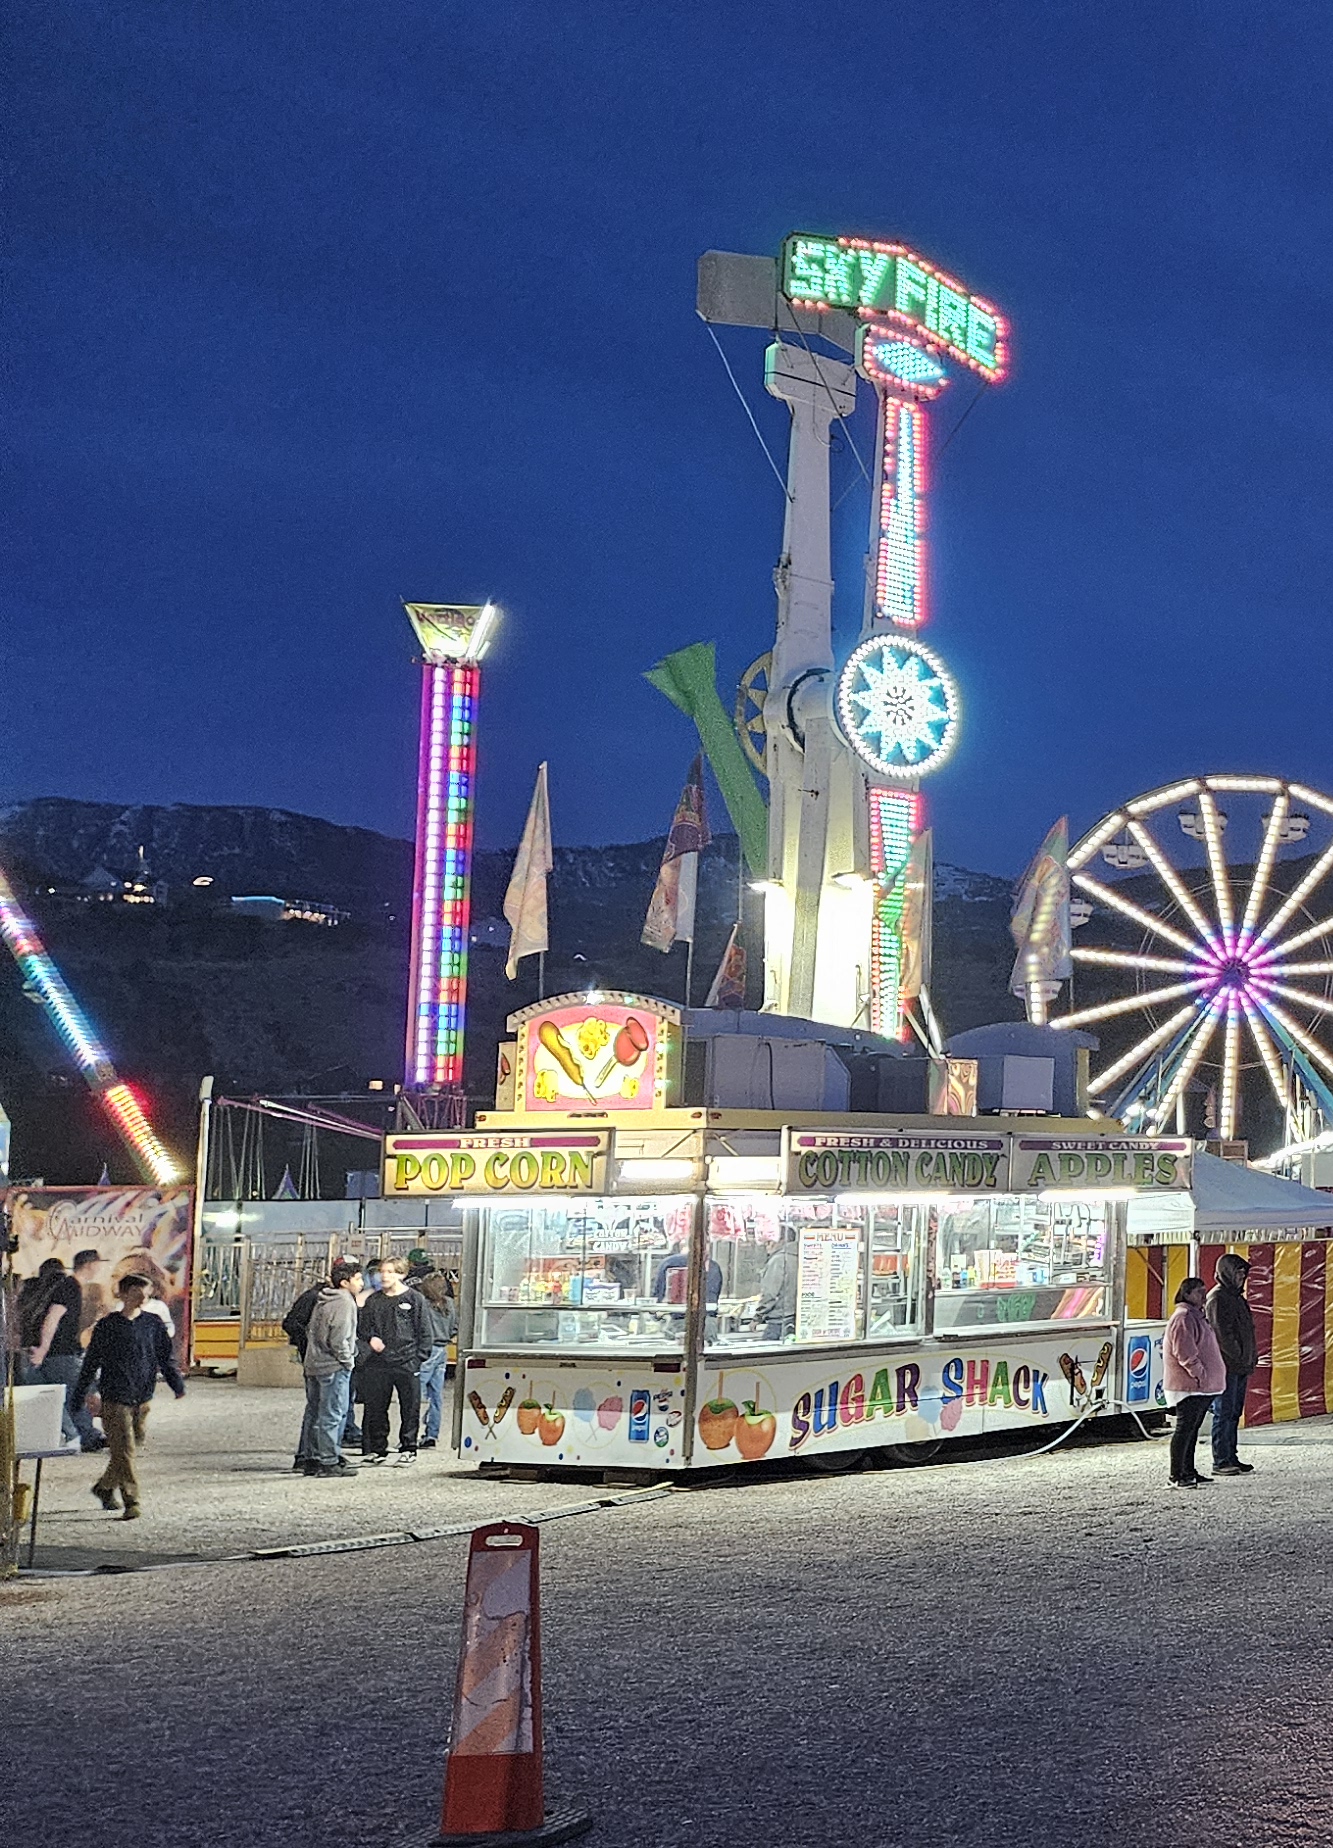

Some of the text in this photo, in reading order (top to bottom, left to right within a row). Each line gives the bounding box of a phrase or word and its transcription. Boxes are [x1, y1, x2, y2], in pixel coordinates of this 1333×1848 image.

[790, 240, 998, 369] SKY FIRE
[460, 1137, 532, 1149] FRESH
[814, 1136, 989, 1150] FRESH & DELICIOUS
[1051, 1141, 1160, 1150] SWEET CANDY
[394, 1150, 595, 1190] POP CORN
[799, 1149, 1001, 1188] COTTON CANDY
[1027, 1152, 1178, 1187] APPLES
[49, 1200, 143, 1233] Carnival
[789, 1357, 1050, 1449] SUGAR SHACK
